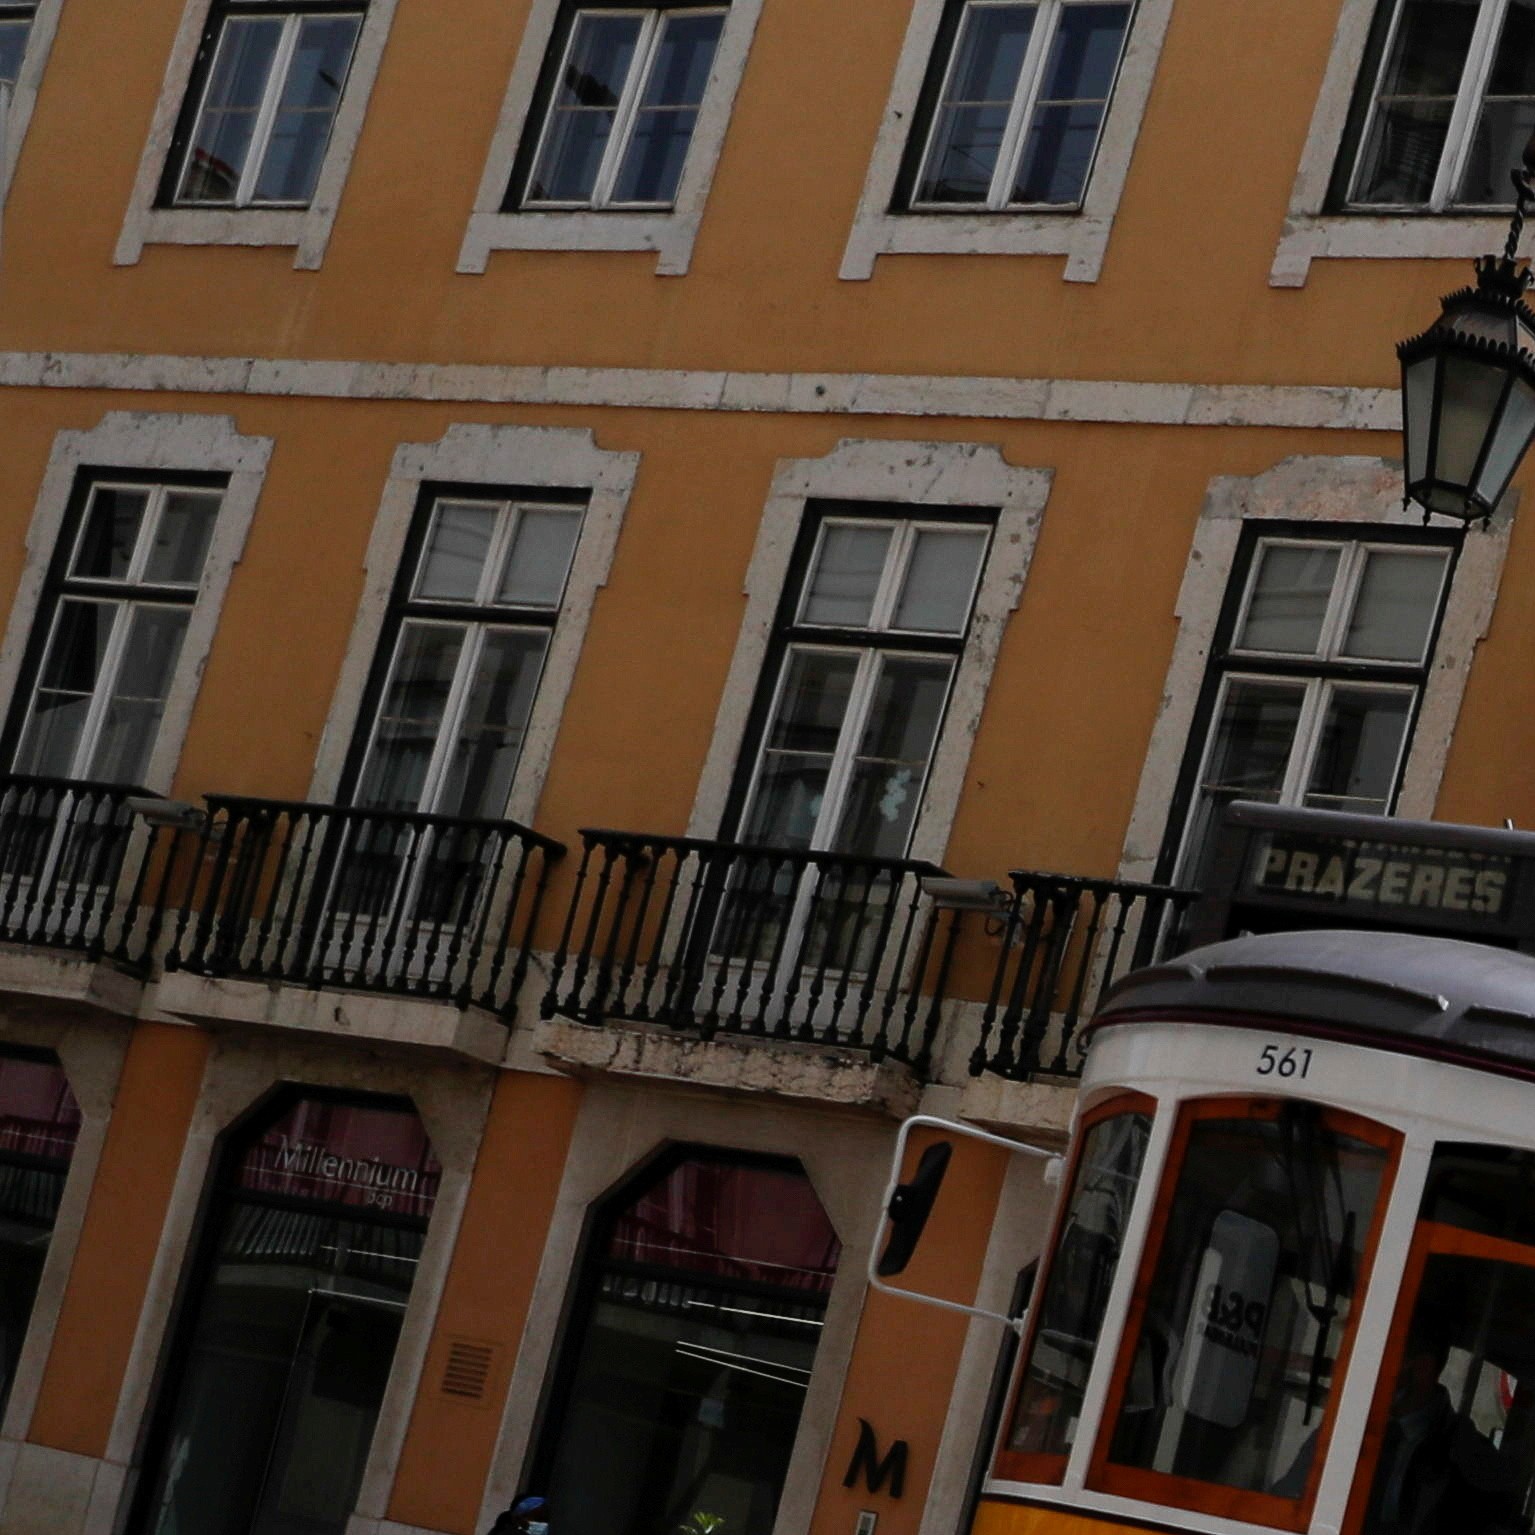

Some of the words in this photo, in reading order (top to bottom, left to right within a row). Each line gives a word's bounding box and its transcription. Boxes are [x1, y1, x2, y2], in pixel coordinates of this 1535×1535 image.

[1257, 846, 1508, 914] PRAZERES
[1257, 1045, 1312, 1079] 561
[274, 1134, 418, 1191] Millennium
[842, 1416, 908, 1500] M
